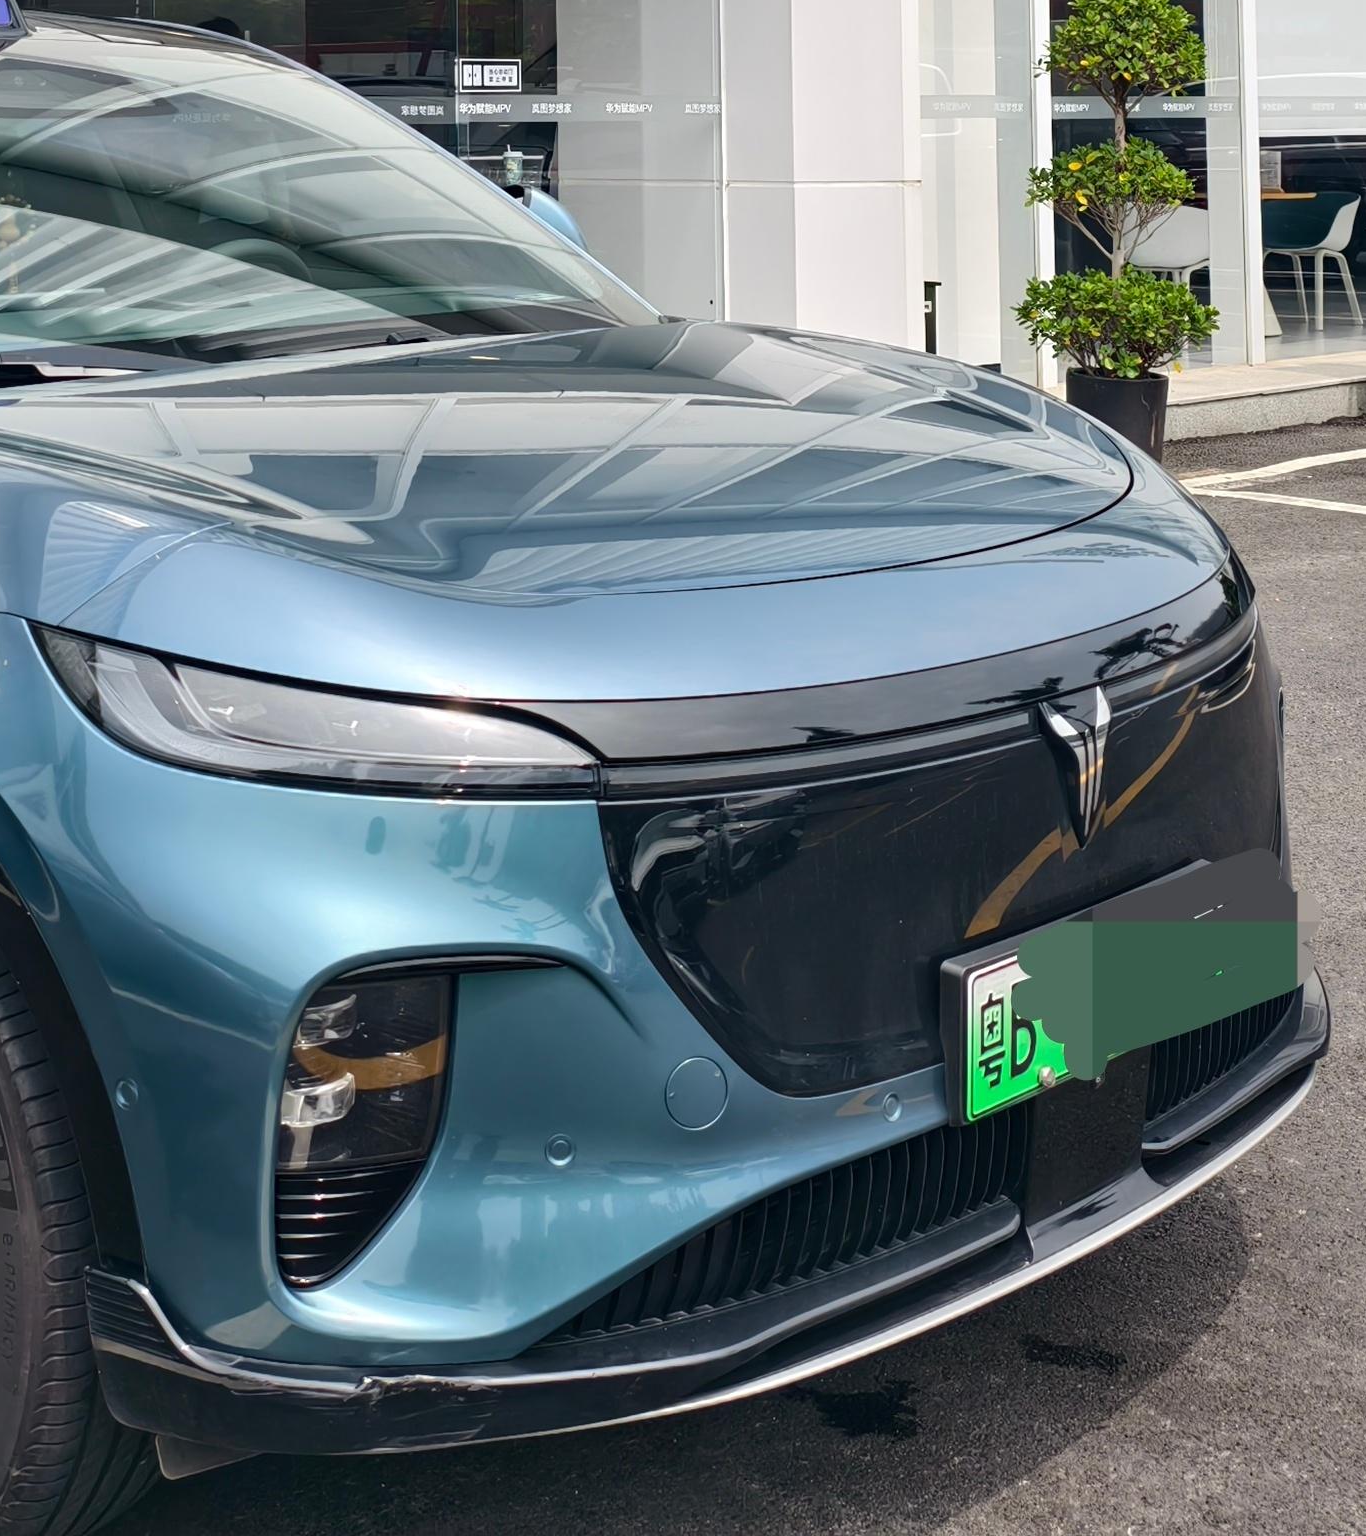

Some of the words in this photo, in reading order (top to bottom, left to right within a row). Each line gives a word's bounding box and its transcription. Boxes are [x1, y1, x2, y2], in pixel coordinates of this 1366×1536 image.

[459, 103, 512, 114] 华为赋能MPV
[531, 103, 572, 114] 岚图梦想家
[605, 102, 653, 114] 华为赋能MPV
